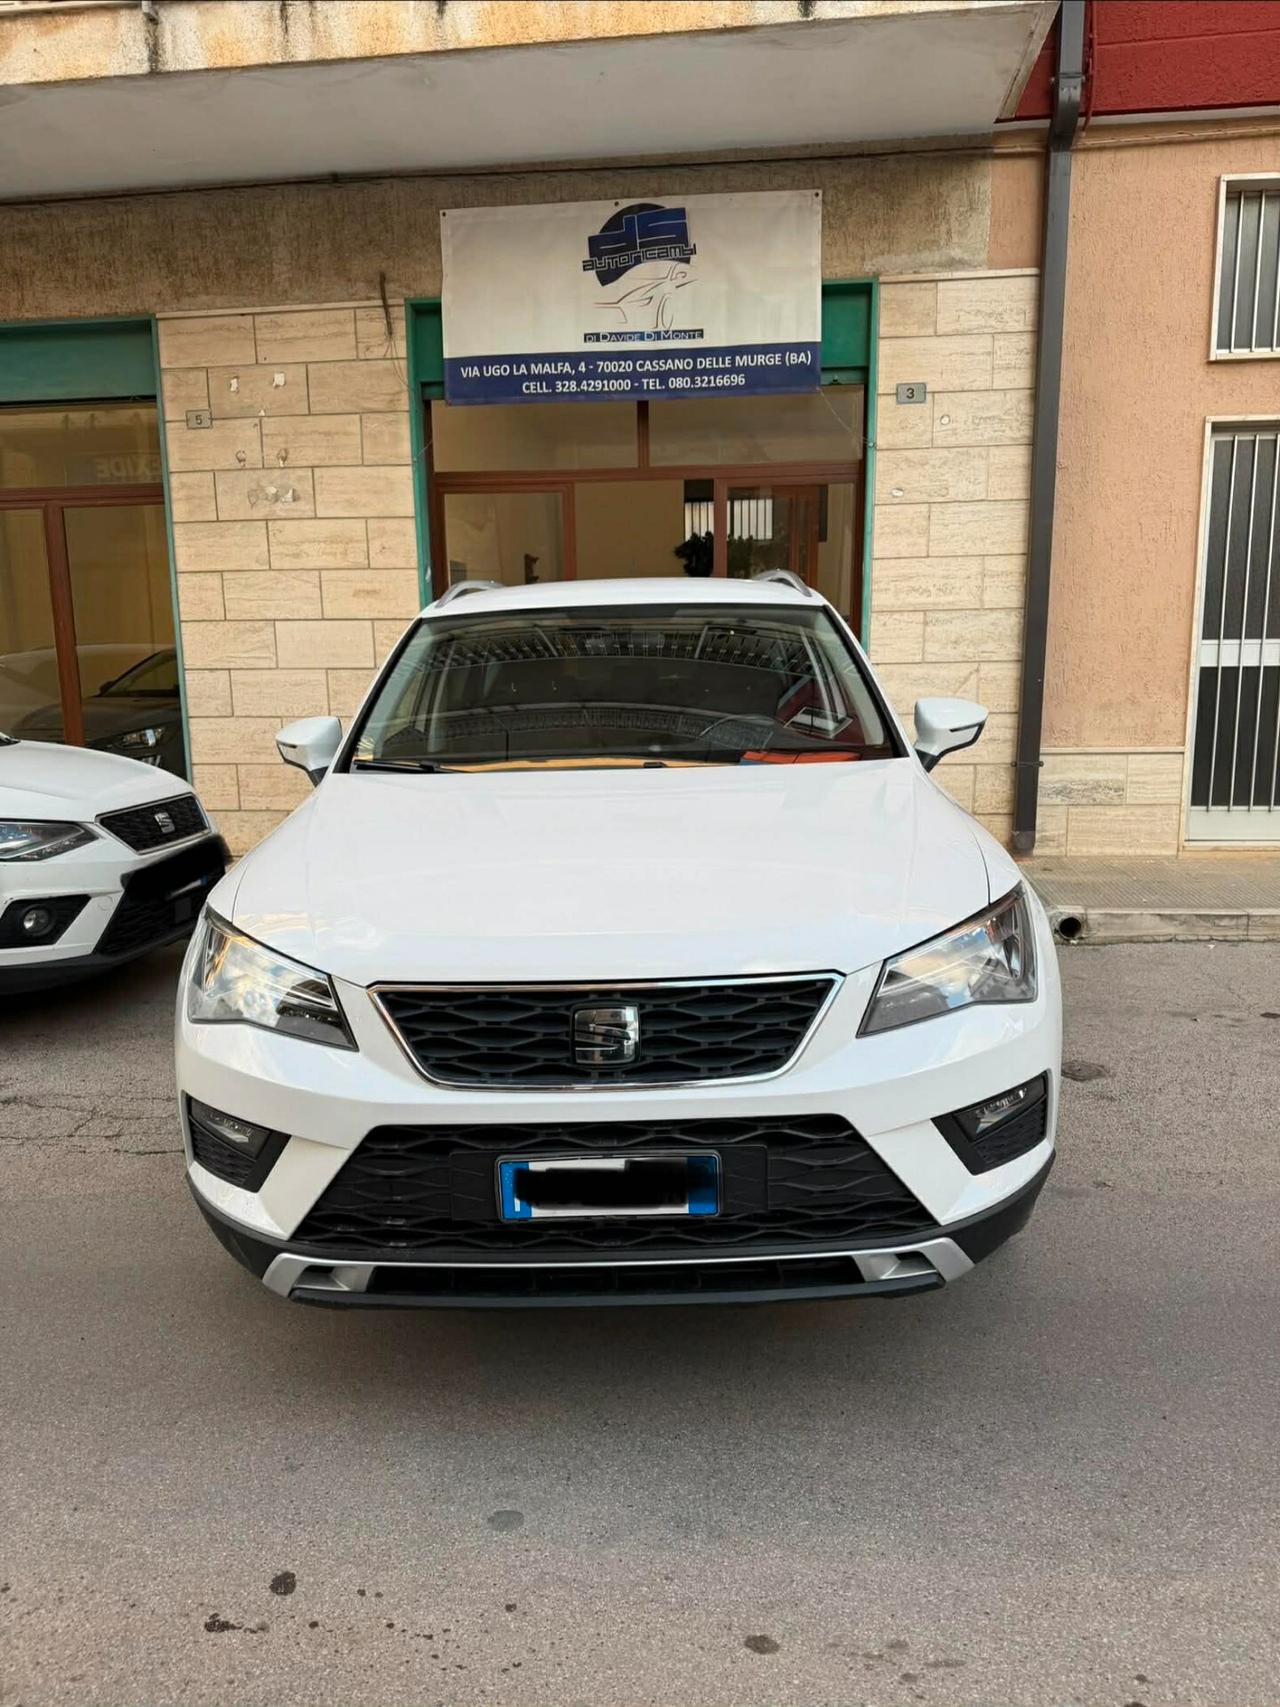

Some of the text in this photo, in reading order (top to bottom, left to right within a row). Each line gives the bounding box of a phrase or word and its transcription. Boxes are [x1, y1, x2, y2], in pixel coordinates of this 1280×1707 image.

[461, 366, 480, 378] VIA
[483, 365, 510, 377] UGO
[513, 364, 528, 375] LA
[530, 362, 575, 376] MALFA,
[578, 361, 586, 373] 4
[597, 360, 633, 373] 70020
[636, 358, 694, 372] CASSANO
[696, 356, 732, 369] DELLE
[735, 353, 782, 367] MURGE
[785, 350, 812, 366] (BA)
[522, 381, 552, 393] CELL.
[555, 379, 631, 393] 328.4291000
[642, 378, 665, 390] TEL.
[668, 374, 746, 389] 080.3216696
[906, 387, 915, 399] 3
[195, 414, 203, 425] 5
